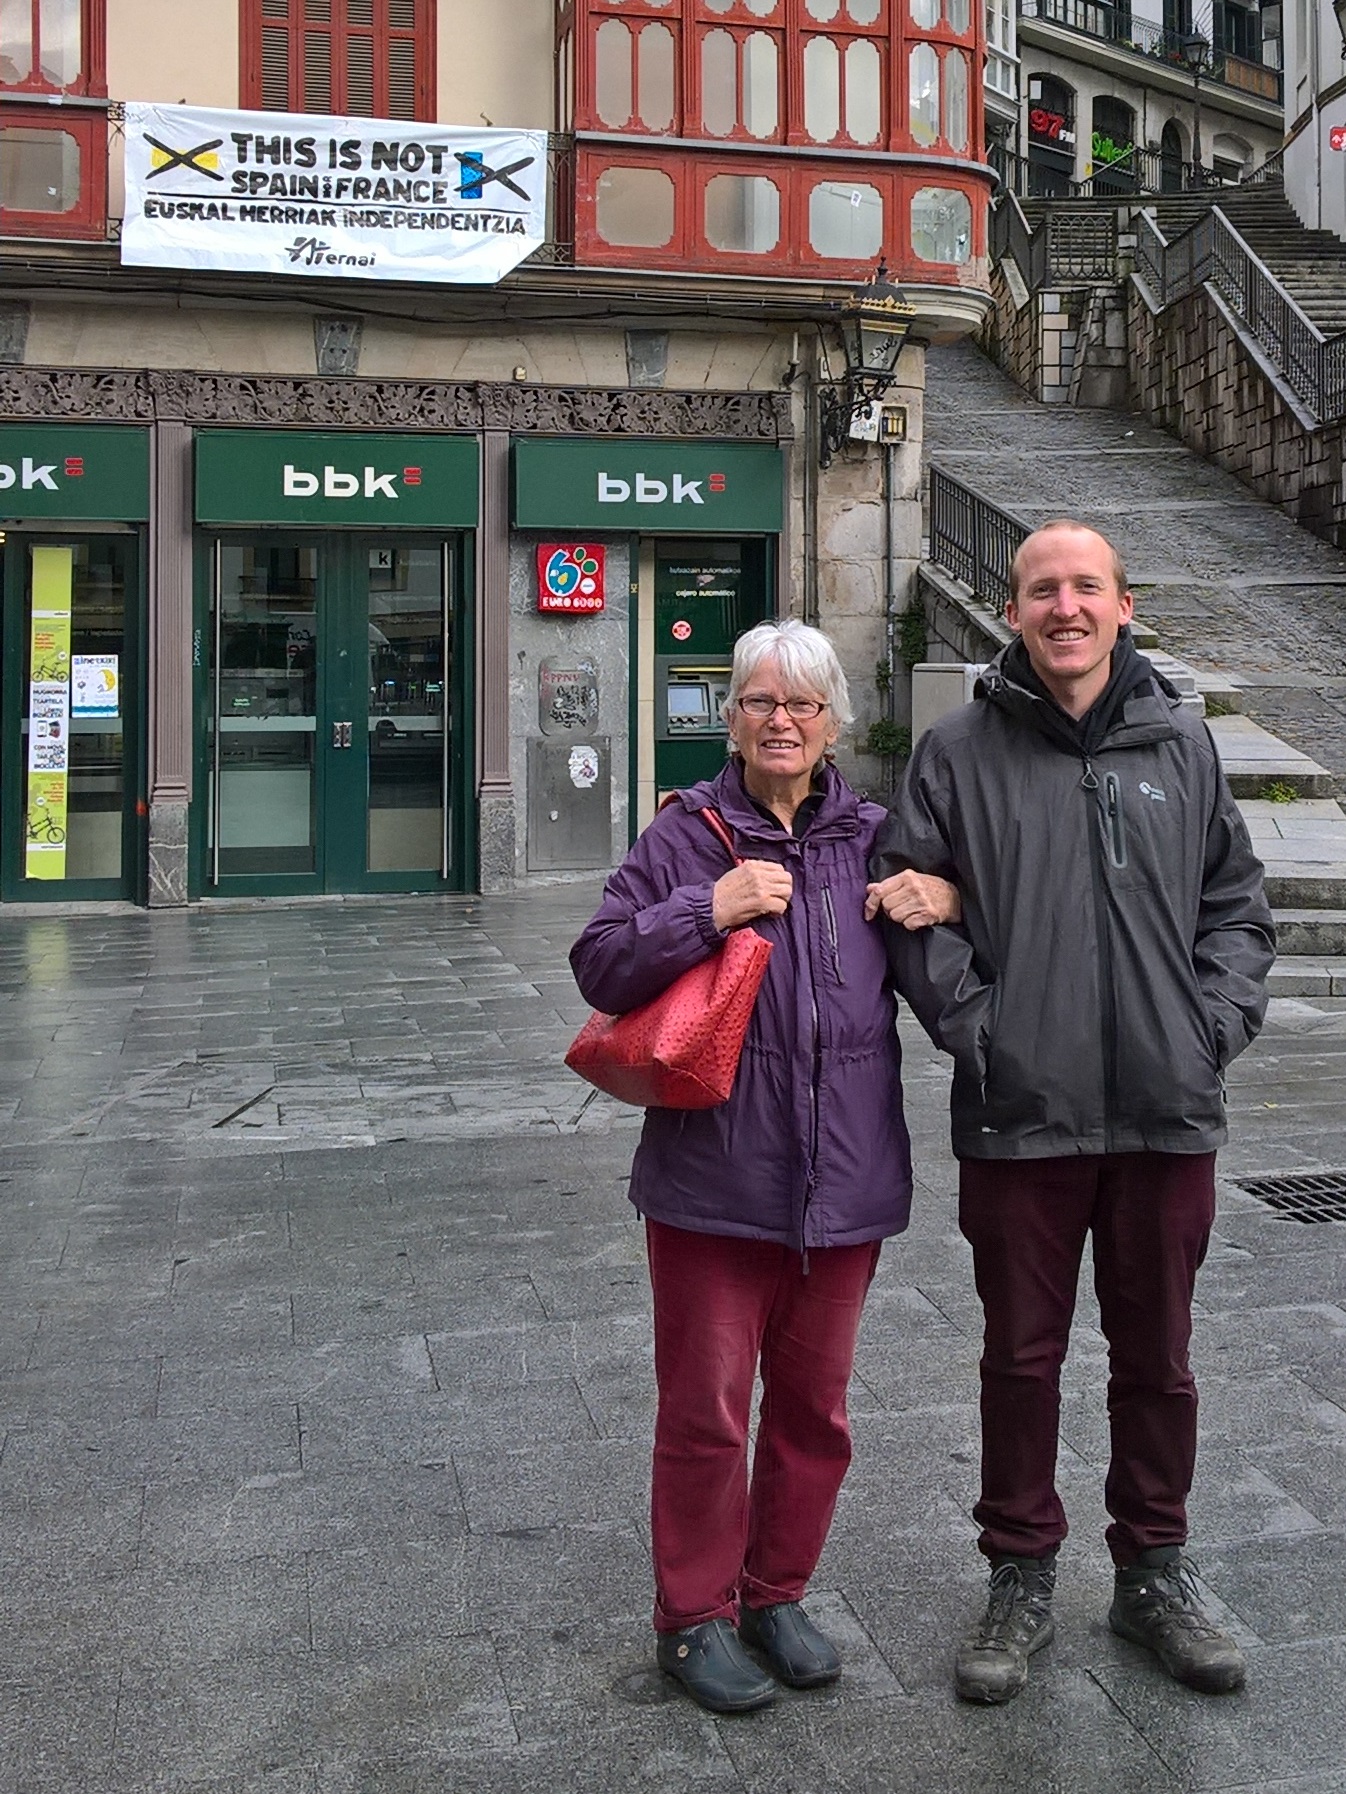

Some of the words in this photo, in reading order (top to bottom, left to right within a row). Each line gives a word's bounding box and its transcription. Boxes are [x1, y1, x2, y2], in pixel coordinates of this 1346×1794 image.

[1030, 109, 1065, 139] 97
[231, 132, 317, 168] THIS
[328, 138, 362, 171] IS
[371, 140, 449, 175] NOT
[231, 169, 319, 199] SPAIN
[335, 176, 449, 204] FRANCE
[144, 199, 235, 222] EUSKAL
[239, 204, 337, 227] HERRIAK
[342, 208, 526, 236] INDEPENDENTZIA
[284, 465, 399, 498] bbk
[598, 472, 705, 504] bbk
[542, 596, 572, 608] EURO
[573, 597, 603, 609] 6000
